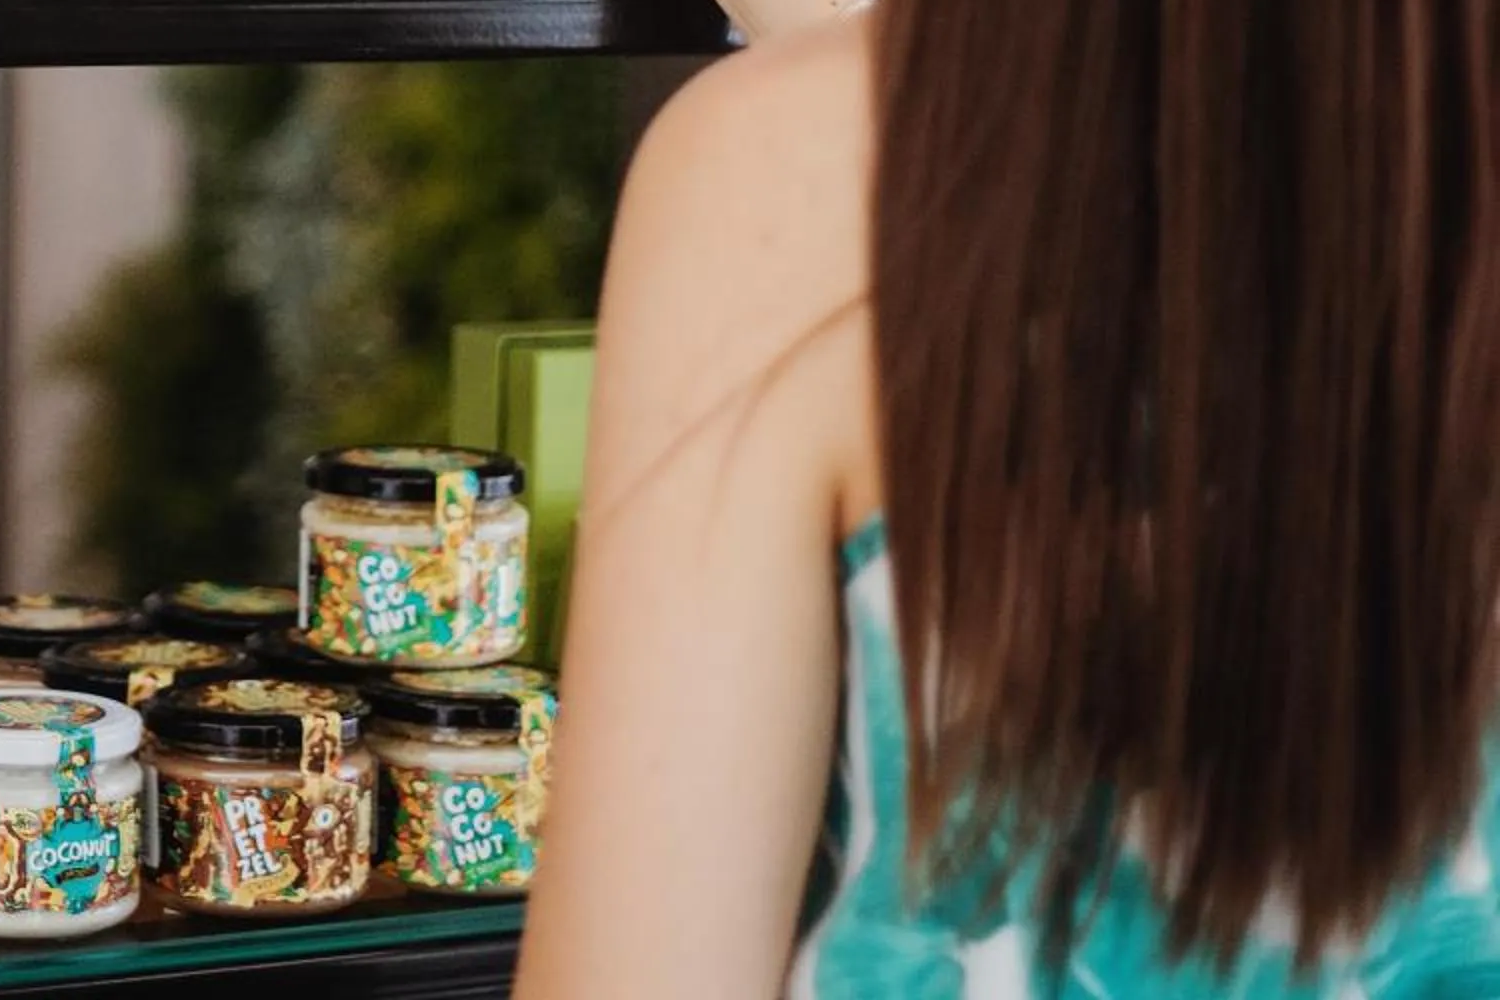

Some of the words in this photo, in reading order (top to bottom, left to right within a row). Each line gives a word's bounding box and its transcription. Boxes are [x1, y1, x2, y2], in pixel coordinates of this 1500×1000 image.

[358, 554, 399, 584] CO
[364, 582, 407, 613] CO
[367, 604, 418, 637] NUT
[223, 795, 266, 832] PR
[443, 785, 486, 814] CO
[234, 822, 268, 858] ET
[451, 812, 493, 843] CO
[29, 832, 117, 871] COCONUT
[236, 850, 283, 881] ZEL
[454, 833, 504, 868] NUT
